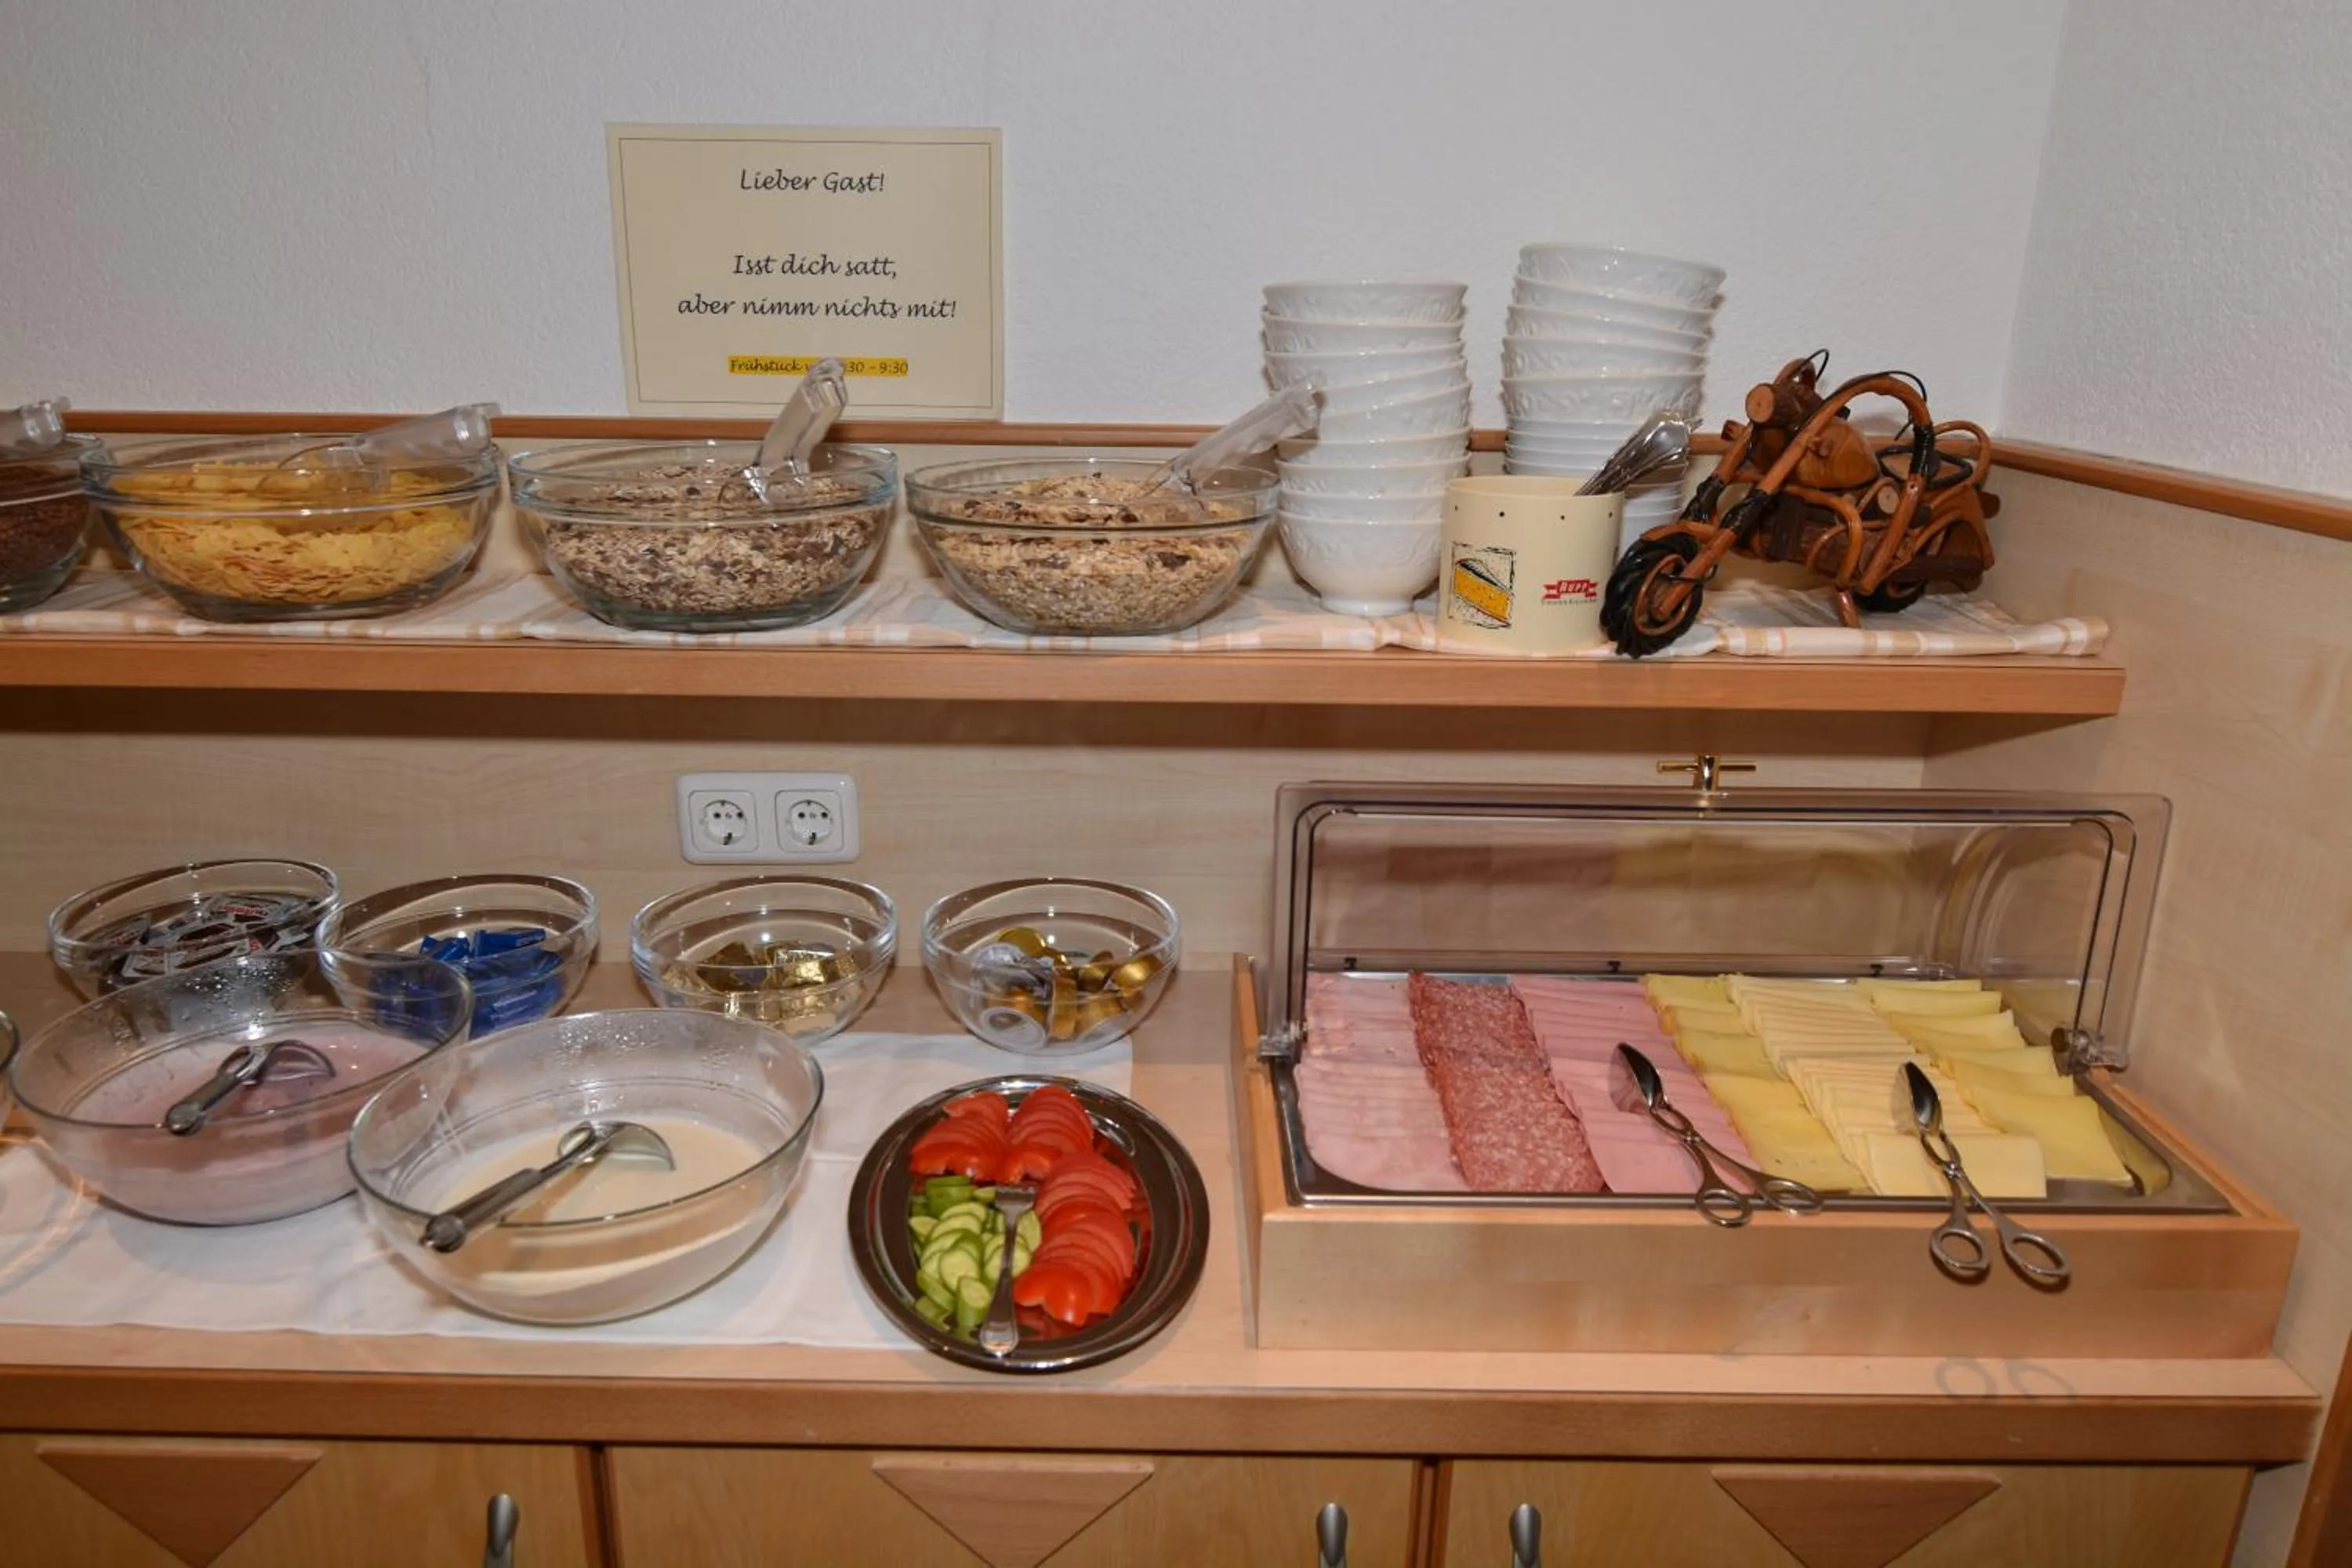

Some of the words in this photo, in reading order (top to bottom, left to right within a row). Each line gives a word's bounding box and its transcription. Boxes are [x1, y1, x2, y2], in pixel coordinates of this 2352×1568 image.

[740, 169, 818, 191] Lieber
[822, 172, 885, 194] Gast!
[732, 254, 777, 276] Isst
[781, 253, 841, 276] dich
[844, 256, 897, 279] satt,
[677, 292, 736, 314] aber
[742, 298, 821, 317] nimm
[825, 296, 902, 319] nichts
[907, 299, 956, 318] mit!
[879, 361, 909, 375] 9:30
